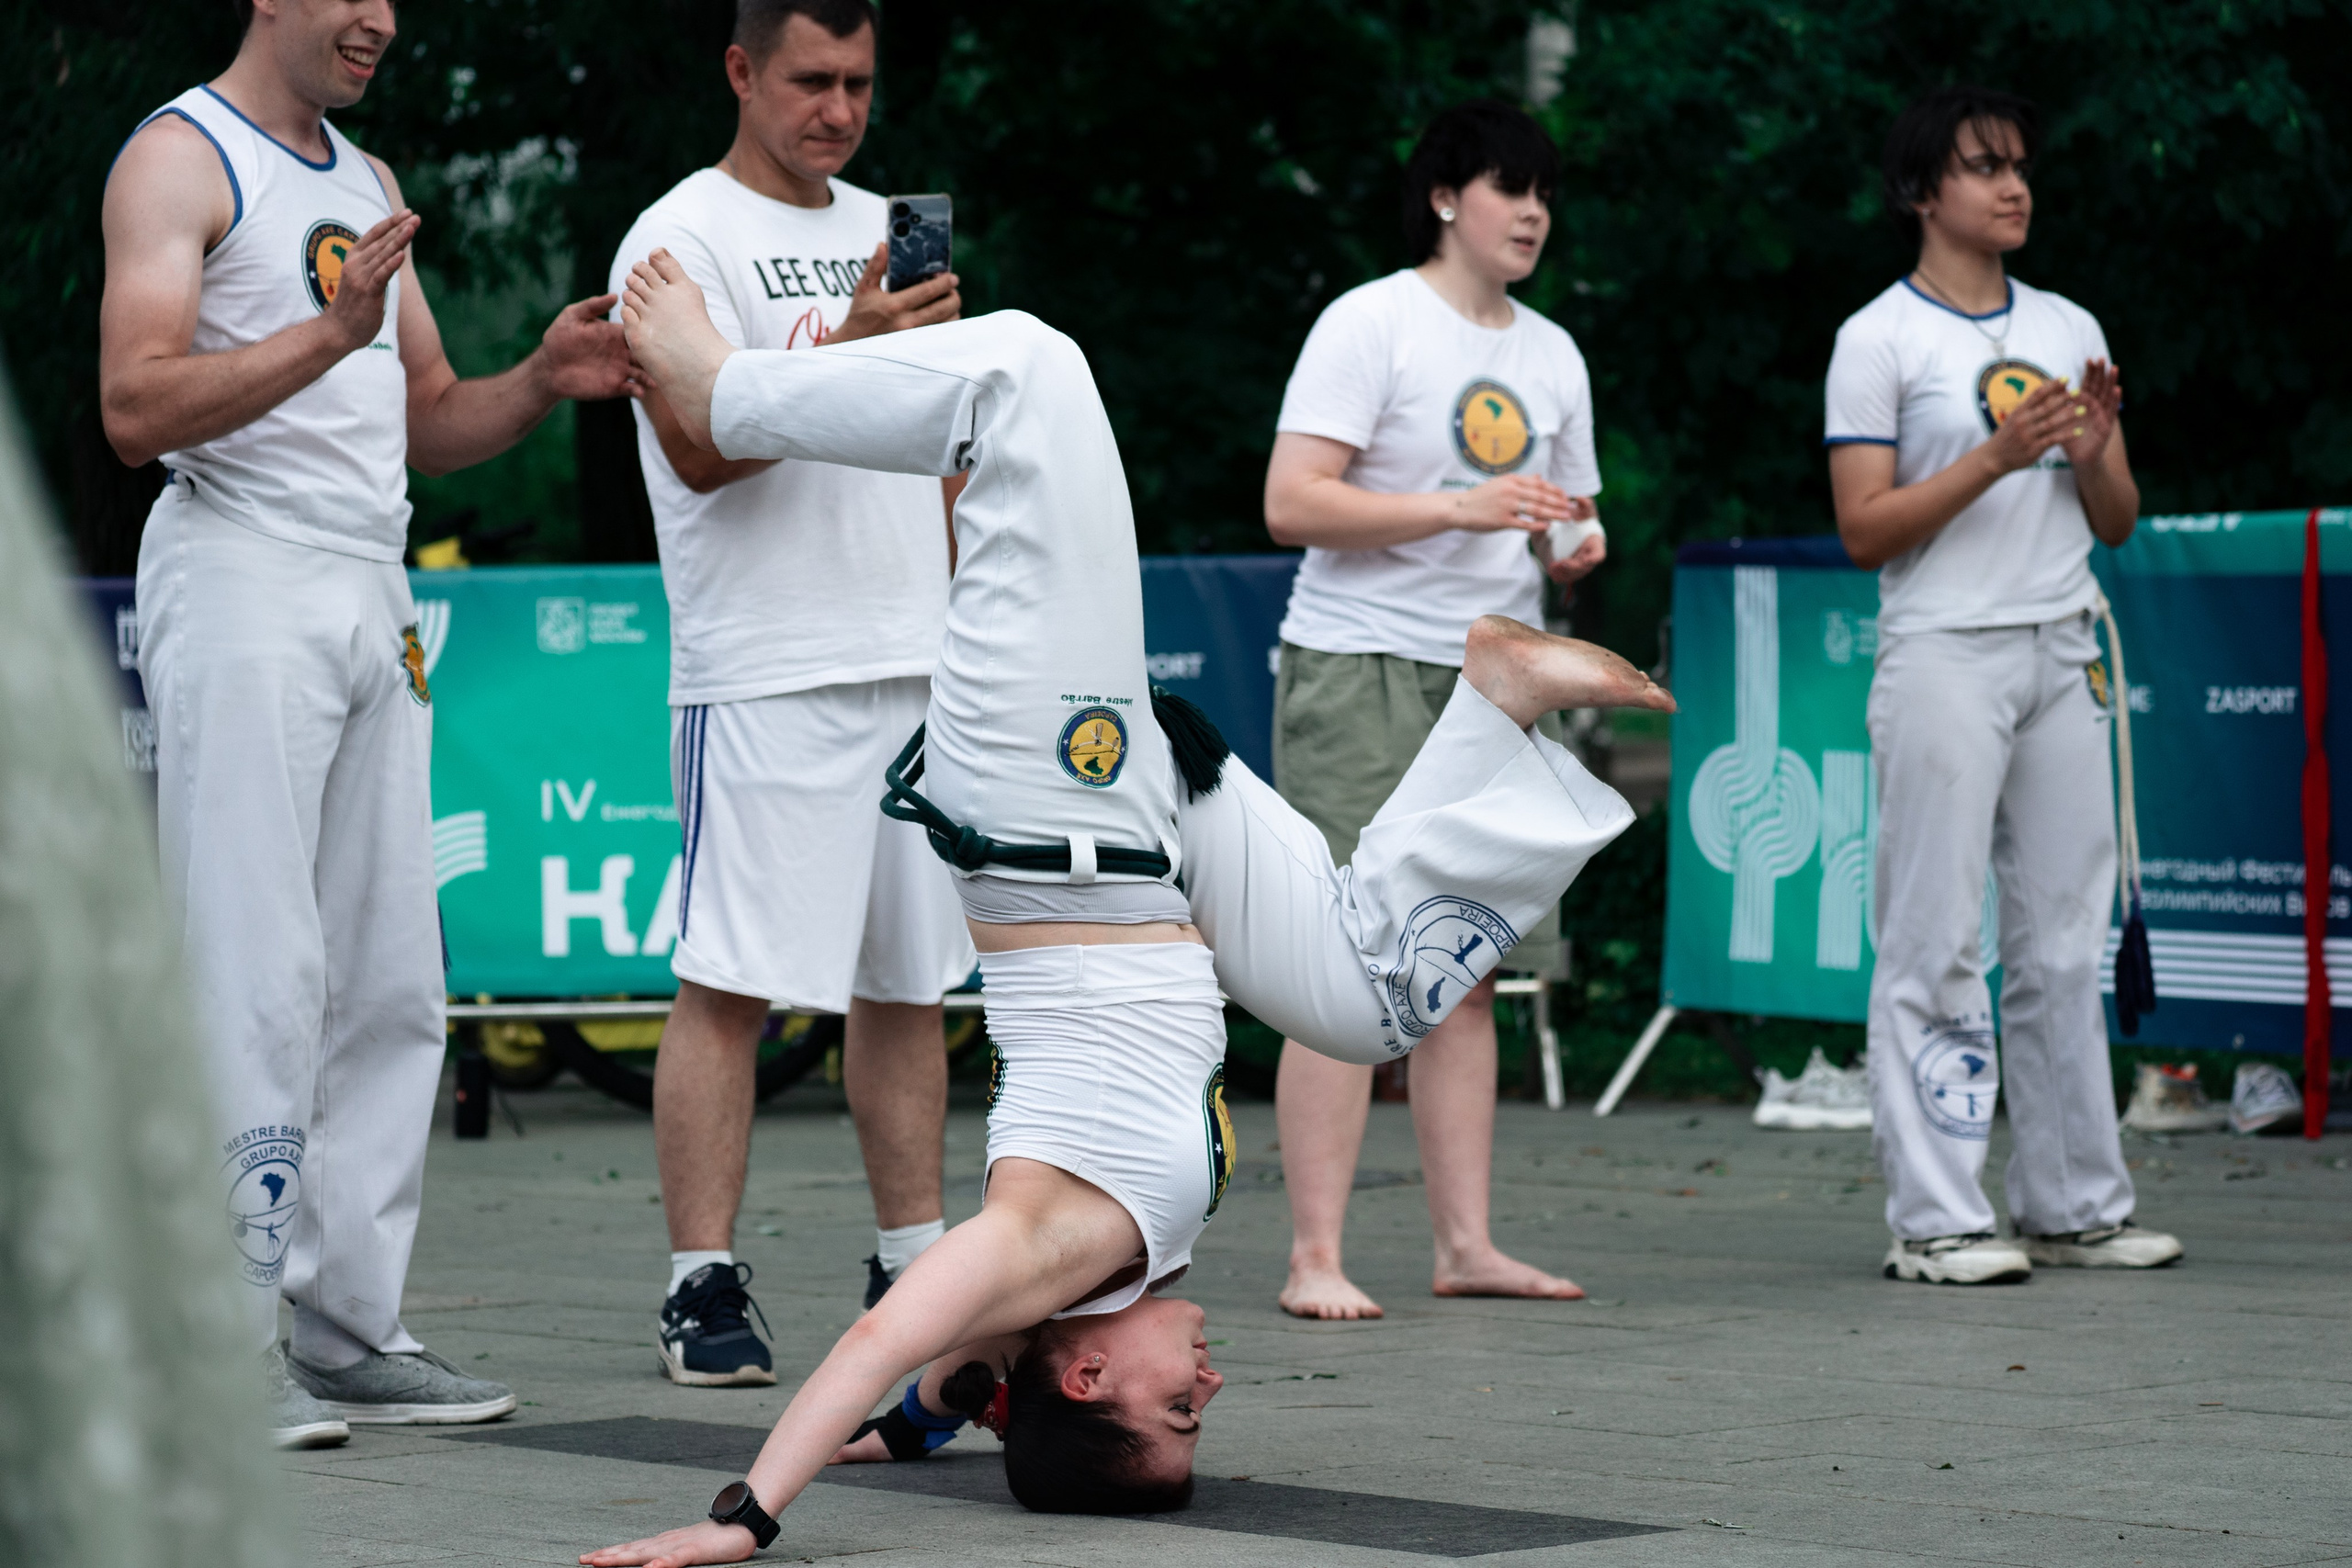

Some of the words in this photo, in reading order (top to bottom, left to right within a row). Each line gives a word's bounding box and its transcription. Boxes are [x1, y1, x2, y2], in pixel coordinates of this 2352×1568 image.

[753, 257, 817, 300] LEE
[812, 259, 869, 298] COO
[2206, 685, 2296, 714] ZASPORT
[541, 779, 597, 822] IV
[1401, 1010, 1435, 1036] RUPO
[223, 1126, 277, 1156] MESTRE
[240, 1145, 287, 1169] GRUPO
